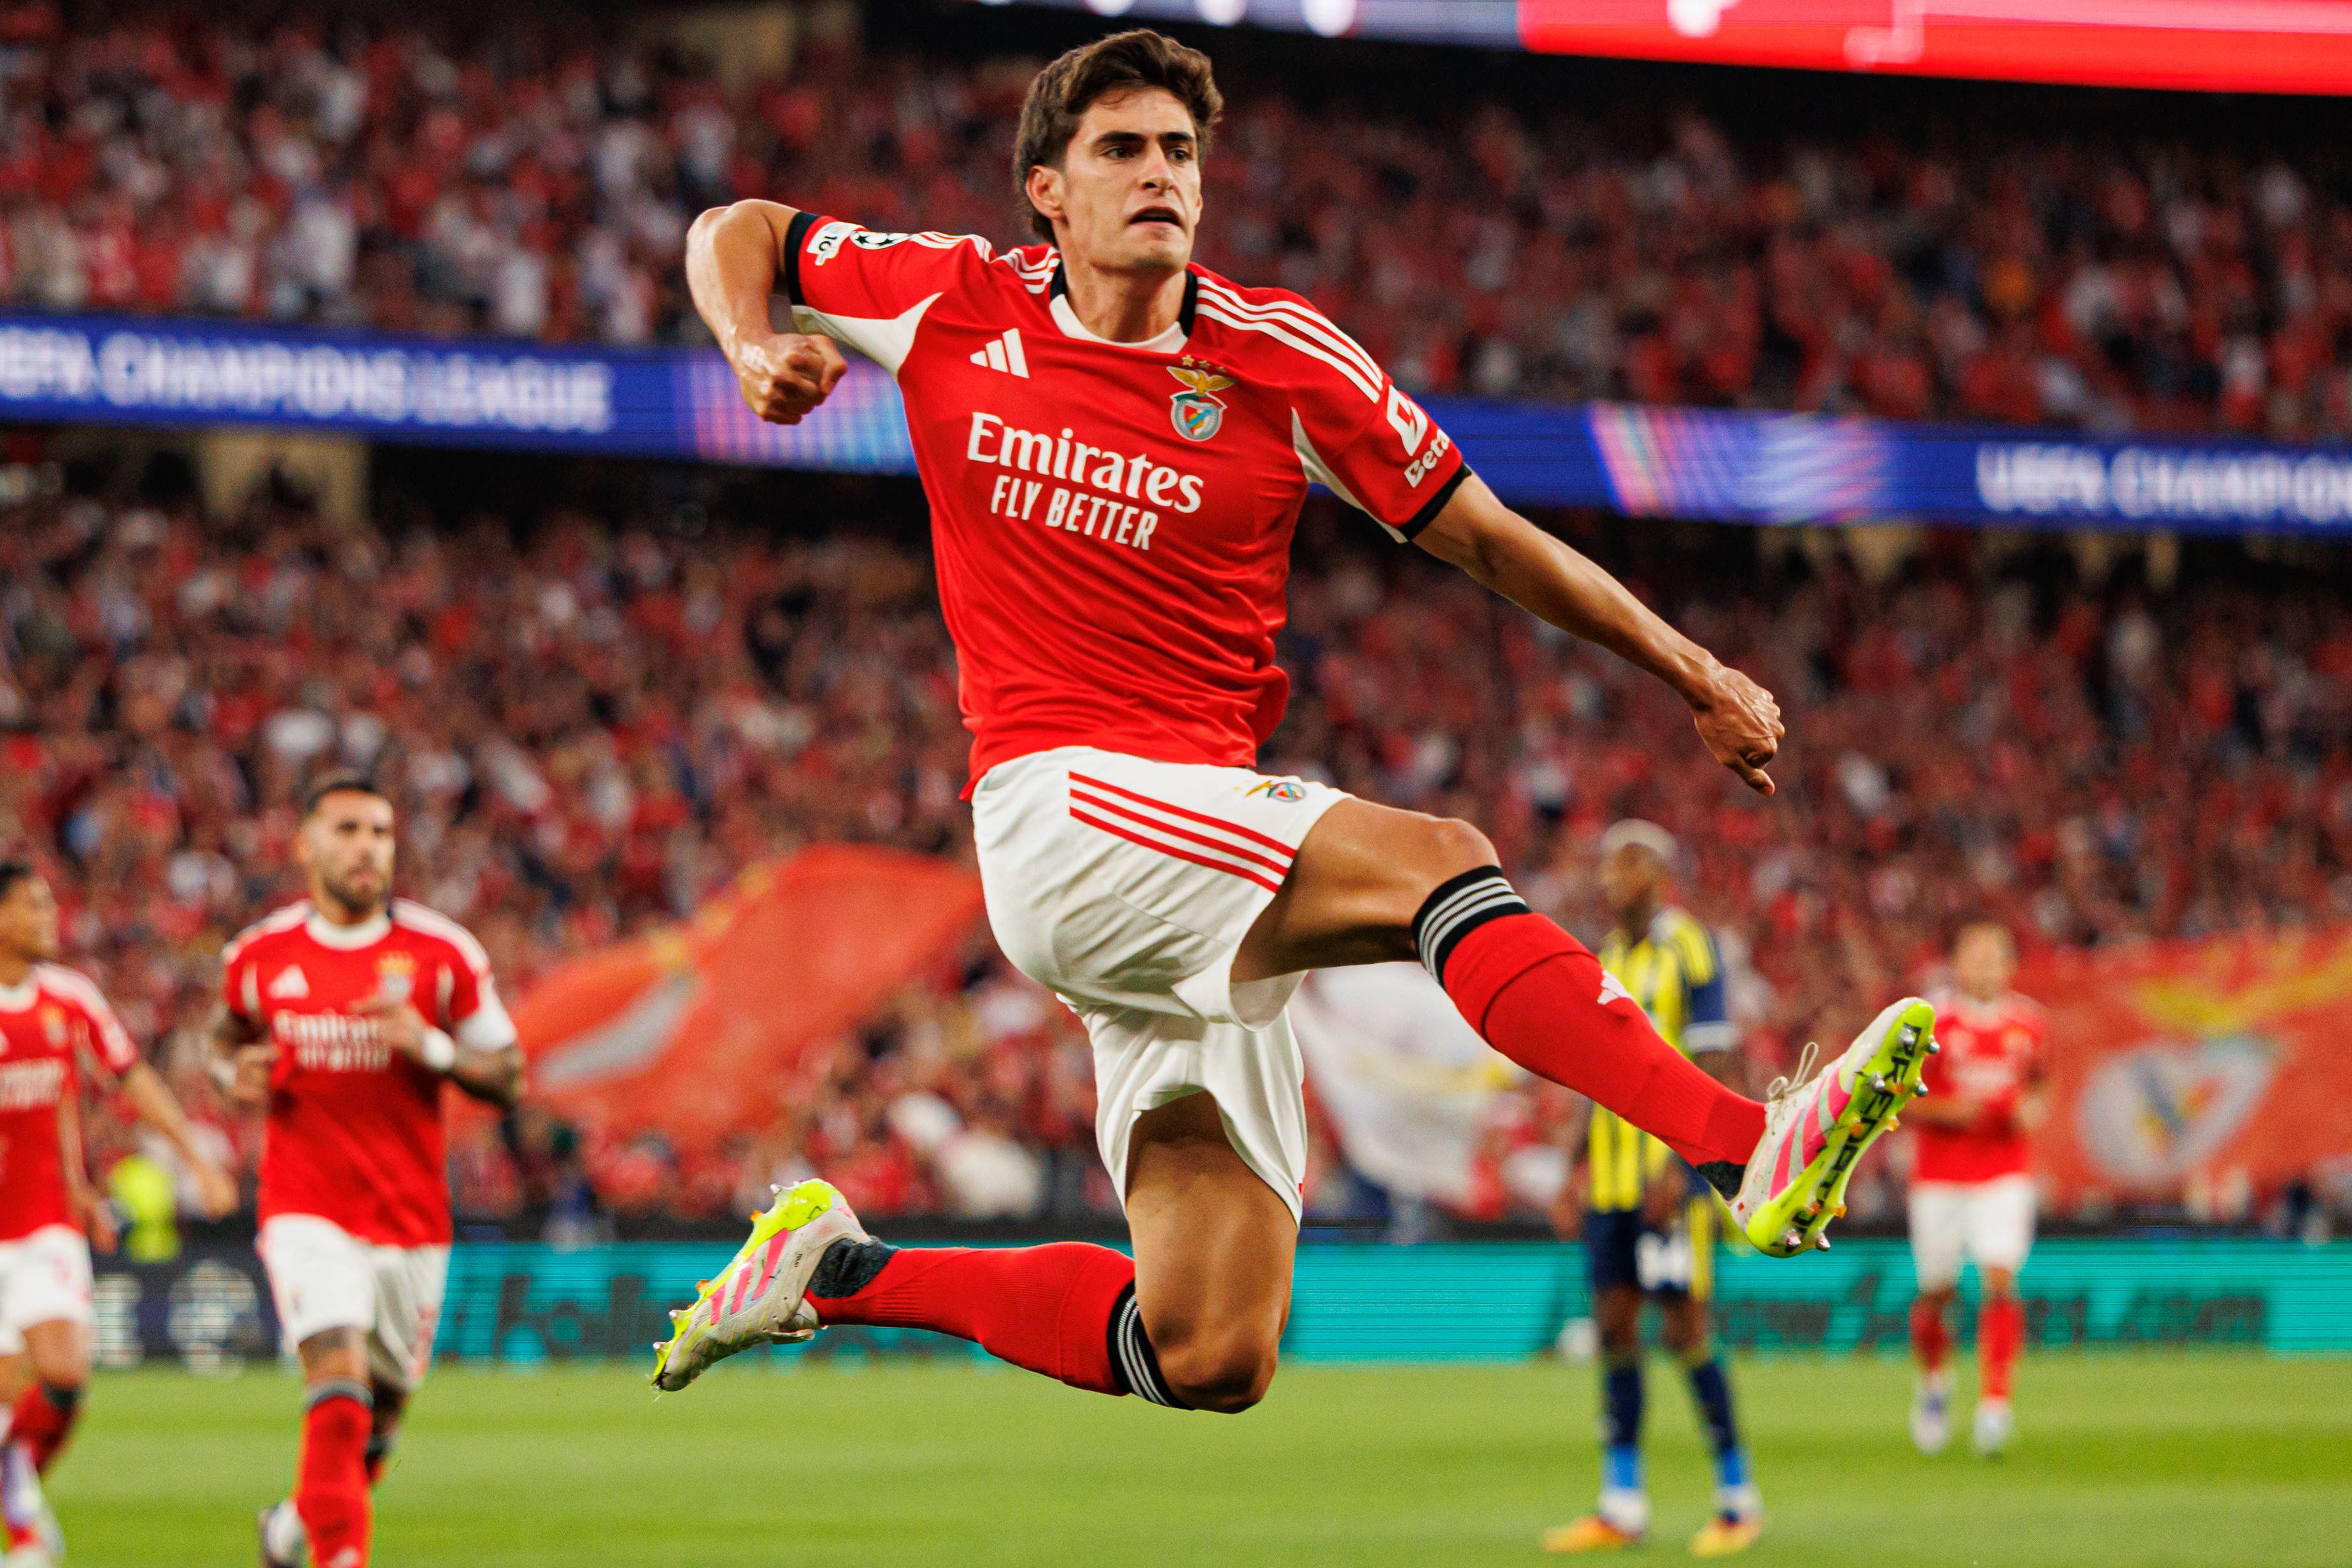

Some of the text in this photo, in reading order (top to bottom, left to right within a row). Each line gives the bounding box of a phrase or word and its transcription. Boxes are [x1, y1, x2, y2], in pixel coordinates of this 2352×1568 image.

[0, 326, 96, 402] EFA
[967, 412, 1203, 513] Emirates
[1976, 441, 2105, 514] UEFA
[991, 475, 1158, 550] FLY BETTER
